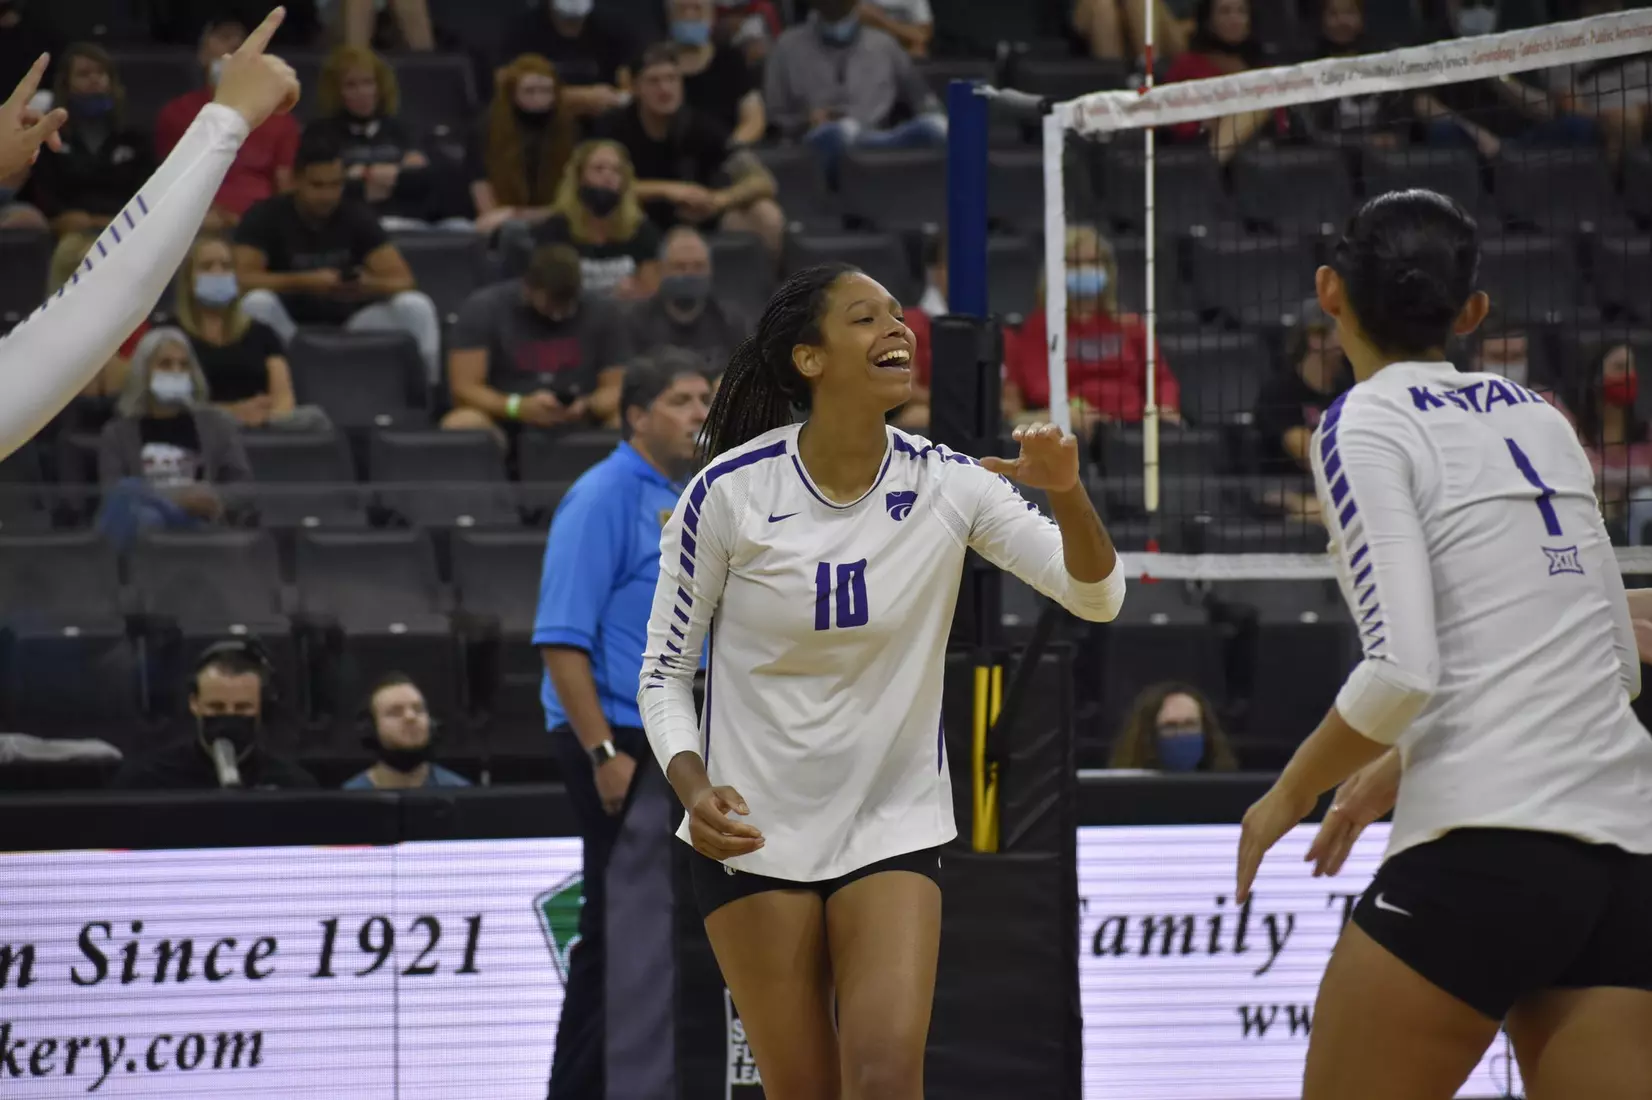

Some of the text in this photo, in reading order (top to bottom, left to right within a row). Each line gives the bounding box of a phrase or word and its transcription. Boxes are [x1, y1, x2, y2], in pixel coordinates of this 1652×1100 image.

[1504, 438, 1563, 536] 1
[815, 558, 868, 631] 10
[70, 920, 278, 987] Since
[311, 914, 483, 977] 1921
[1079, 893, 1295, 977] amily
